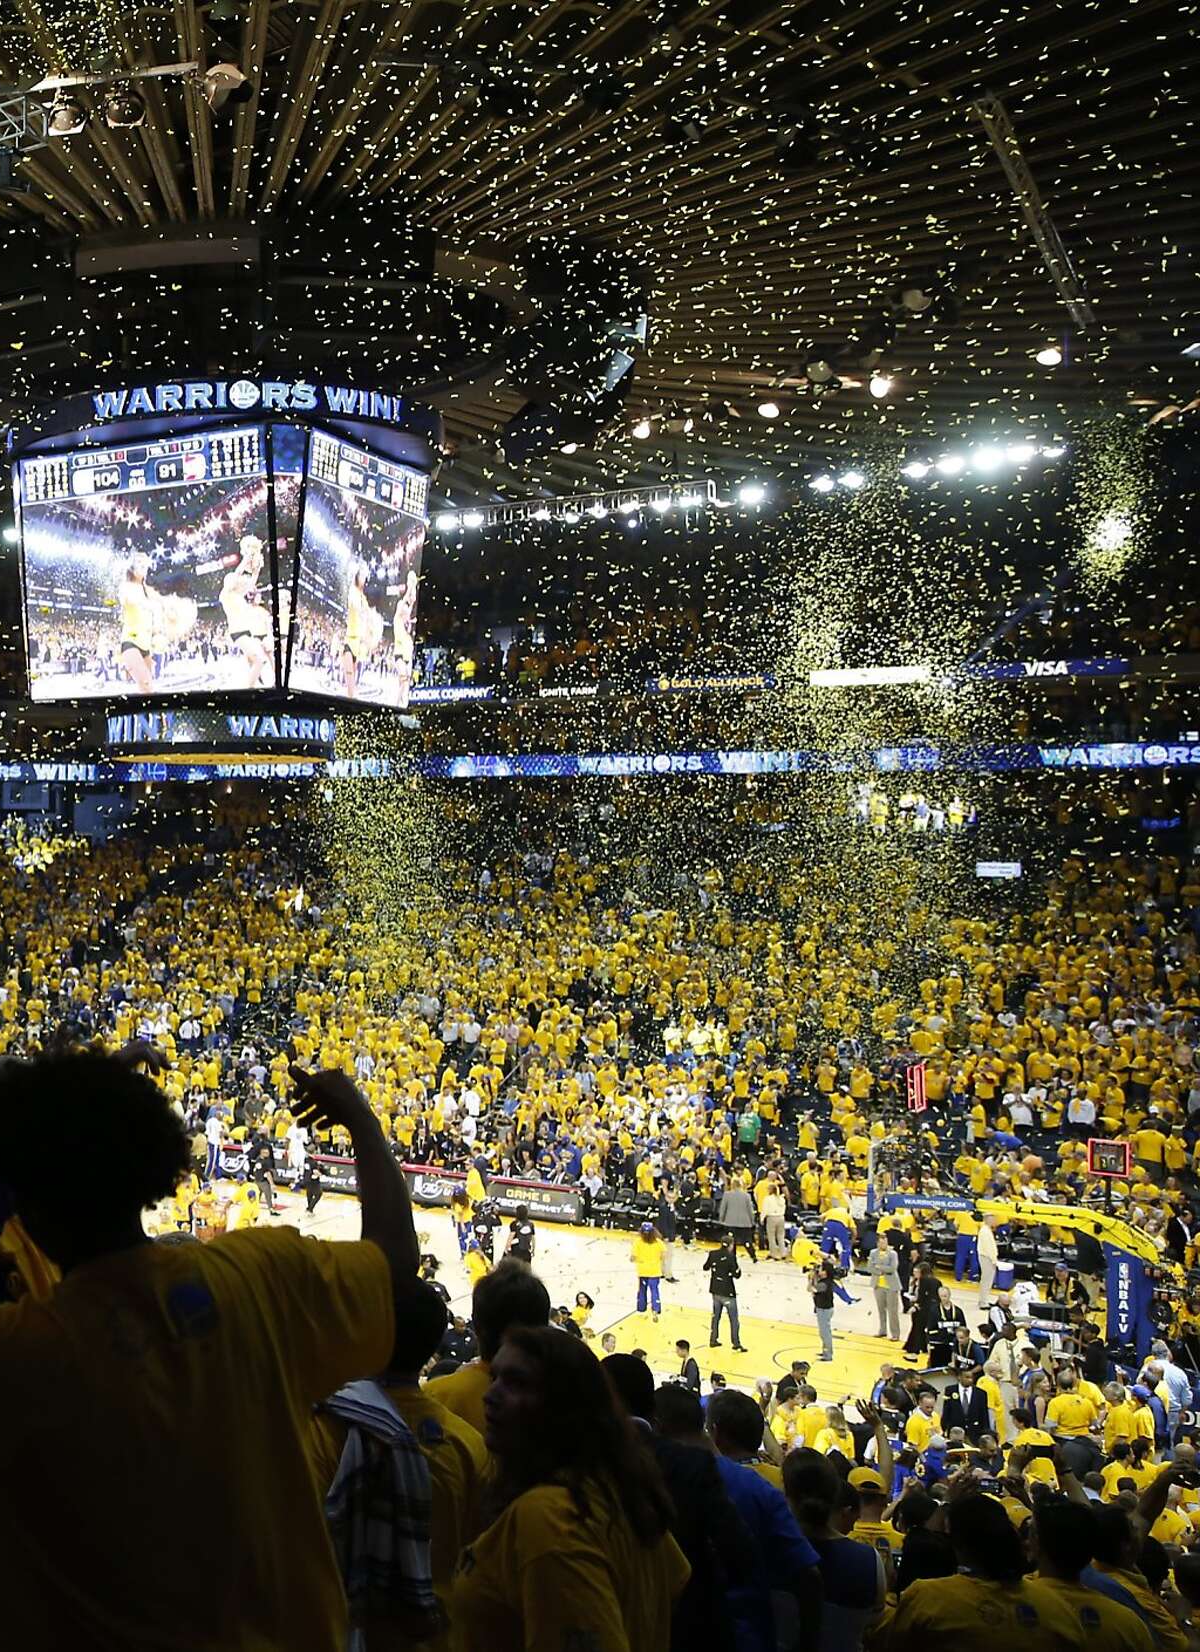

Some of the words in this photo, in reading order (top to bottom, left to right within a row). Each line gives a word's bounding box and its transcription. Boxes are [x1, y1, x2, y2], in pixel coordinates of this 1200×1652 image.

[93, 380, 318, 417] WARRIORS
[324, 385, 400, 420] WIN!
[159, 463, 177, 478] 91
[94, 472, 119, 487] 104
[1024, 660, 1069, 676] VISA
[671, 680, 703, 688] GOLD
[705, 677, 763, 687] ALLIANCE
[409, 690, 439, 700] LOROX
[441, 688, 488, 699] COMPANY
[108, 713, 174, 743] WIN!
[227, 715, 335, 742] WARRIO
[1038, 746, 1200, 766] WARRIORS
[34, 764, 96, 780] WIN!
[216, 763, 314, 777] WARRIORS
[578, 755, 702, 774] WARRIORS
[506, 1188, 539, 1201] GAME
[904, 1199, 966, 1209] WARRIORS.COM
[1118, 1279, 1129, 1310] NBA
[1118, 1312, 1129, 1334] TV
